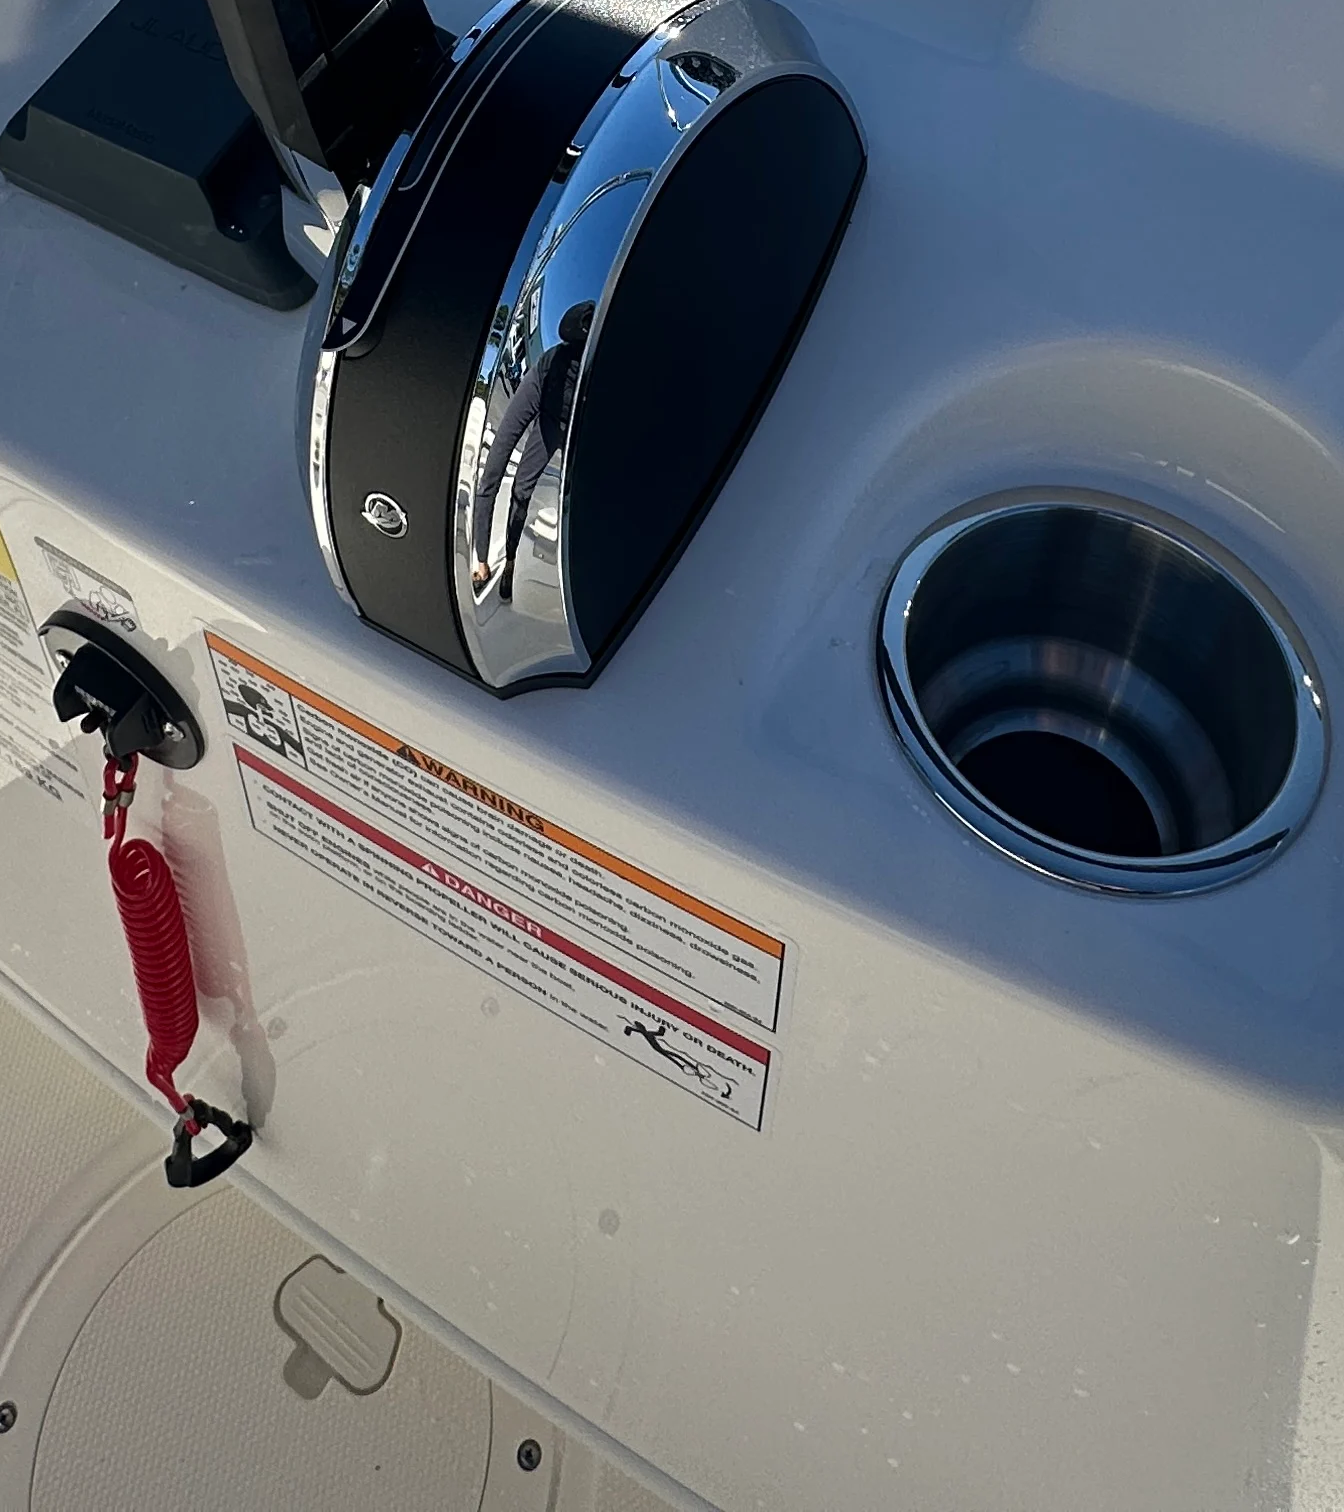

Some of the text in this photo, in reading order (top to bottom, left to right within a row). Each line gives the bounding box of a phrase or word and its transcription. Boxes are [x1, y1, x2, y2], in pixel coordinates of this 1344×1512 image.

[335, 736, 355, 752] and
[356, 748, 405, 781] generator
[547, 853, 568, 871] and
[571, 866, 623, 901] colorless
[669, 917, 729, 958] monoxide
[336, 726, 389, 761] monoxide
[391, 756, 419, 779] (CO)
[441, 786, 474, 809] cause
[505, 819, 552, 853] damage
[370, 783, 407, 810] anyone
[440, 822, 468, 846] signs
[469, 839, 481, 851] of
[482, 846, 519, 873] carbon
[519, 866, 573, 903] monoxide
[420, 753, 545, 835] WARNING
[261, 782, 314, 821] CONTACT
[315, 815, 345, 840] WITH
[346, 834, 356, 847] A
[357, 841, 414, 882] SPINNING
[415, 876, 487, 925] PROPELLER
[489, 920, 520, 944] WILL
[523, 939, 566, 971] CAUSE
[569, 965, 627, 1006] SERIOUS
[630, 1000, 680, 1036] INJURY
[682, 1029, 704, 1048] OR
[706, 1042, 757, 1078] DEATH.
[265, 799, 295, 823] SHUT
[296, 818, 320, 838] OFF
[320, 833, 371, 870] ENGINES
[459, 918, 475, 934] the
[477, 930, 504, 951] water
[506, 947, 528, 965] near
[272, 823, 309, 851] NEVER
[309, 846, 361, 884] OPERATE
[361, 879, 374, 892] IN
[375, 887, 429, 926] REVERSE
[430, 921, 483, 958] TOWARD
[484, 953, 494, 965] A
[496, 960, 547, 997] PERSON
[549, 992, 559, 1004] in
[560, 998, 578, 1015] the
[424, 823, 482, 862] information
[483, 857, 535, 893] regarding
[537, 887, 576, 915] carbon
[578, 909, 633, 947] monoxide
[636, 941, 695, 982] poisoning.
[429, 798, 480, 834] poisoning
[481, 827, 521, 856] include
[568, 875, 625, 914] headache,
[629, 908, 685, 946] dizziness,
[688, 939, 761, 986] drowsiness,
[443, 872, 543, 940] DANGER
